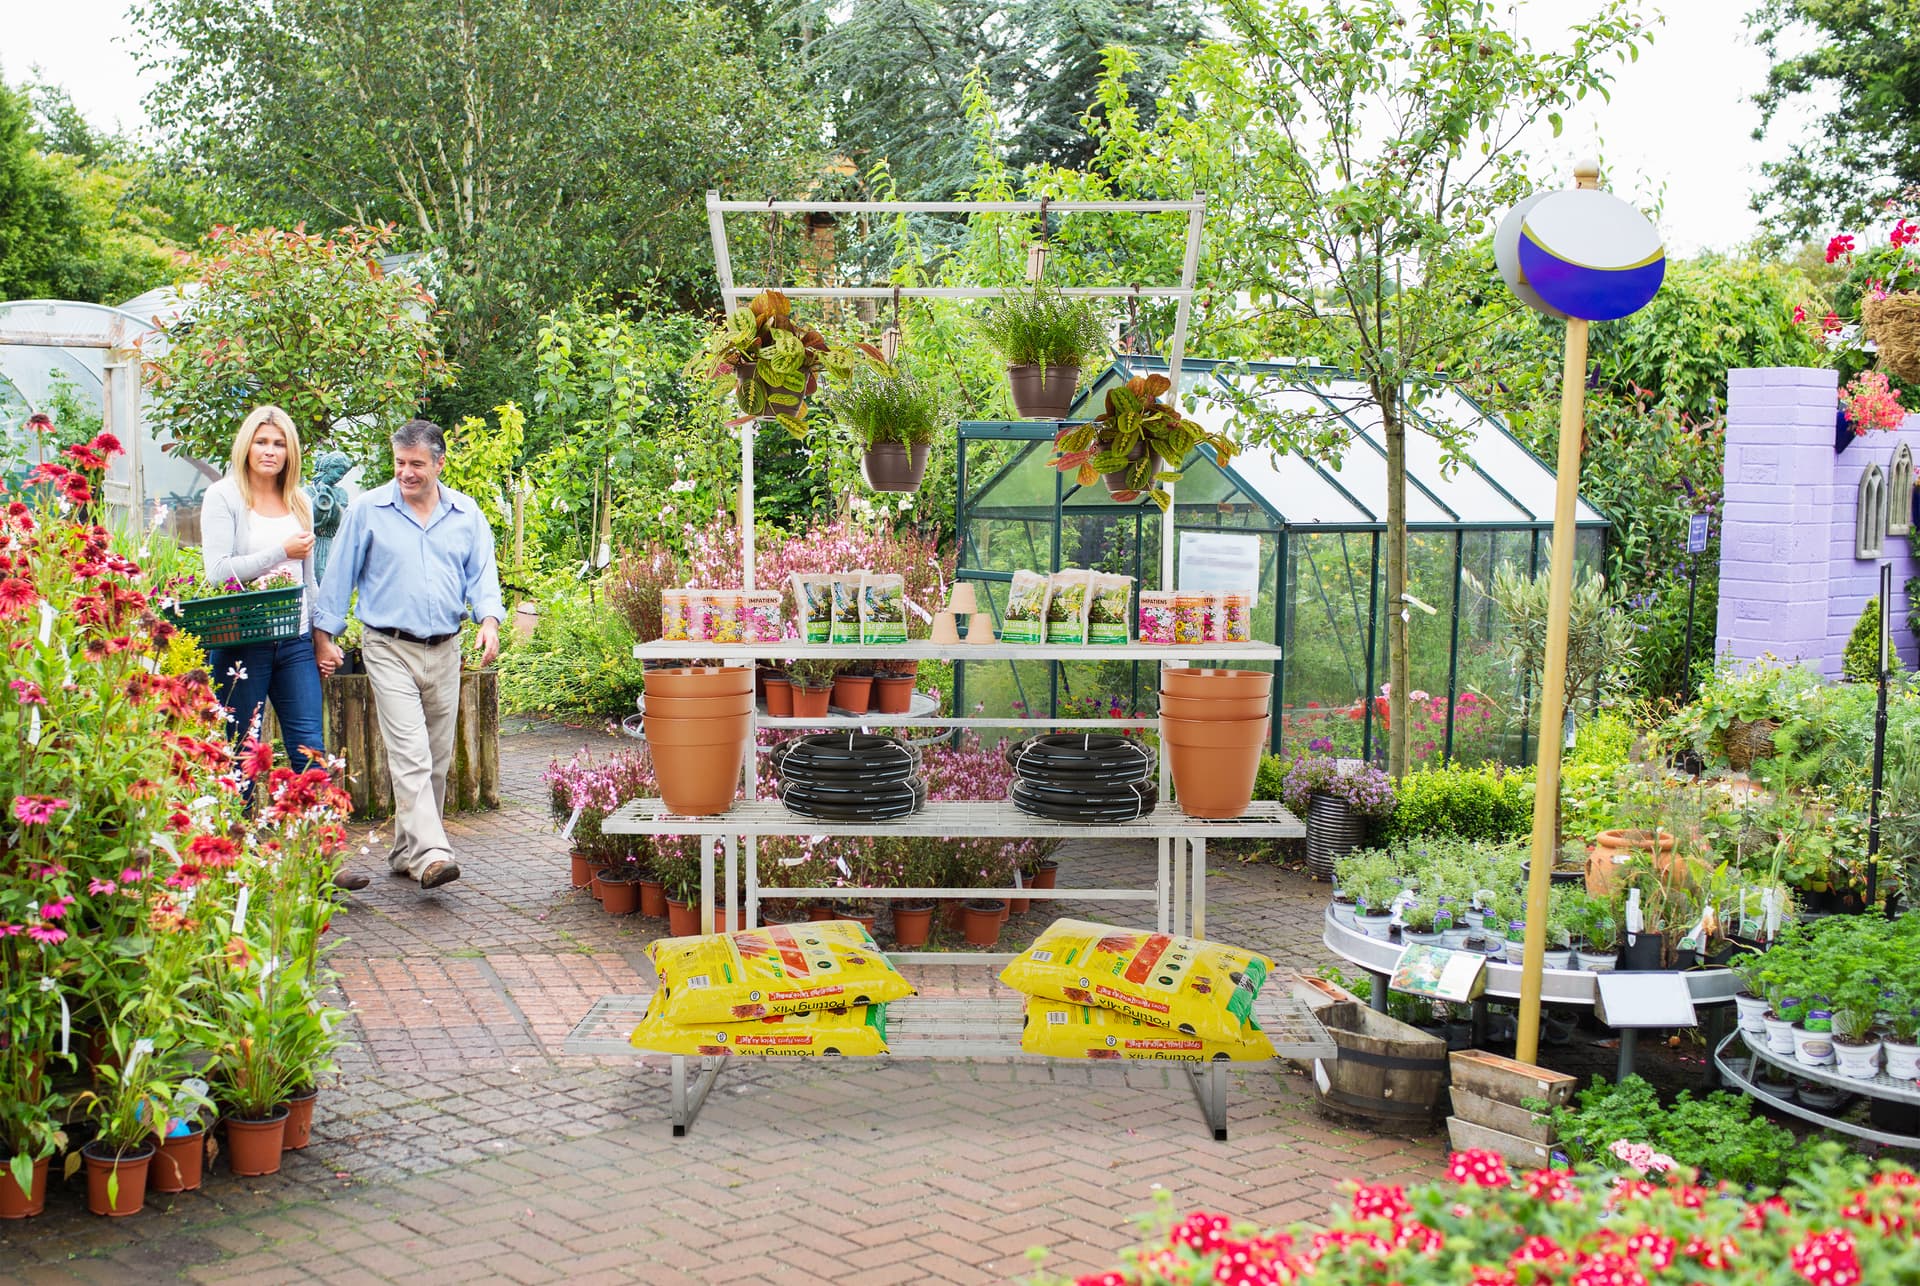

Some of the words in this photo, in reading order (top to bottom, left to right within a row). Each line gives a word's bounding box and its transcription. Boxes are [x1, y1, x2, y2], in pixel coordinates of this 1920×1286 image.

[773, 1004, 796, 1013] Mix
[798, 999, 846, 1011] Potting
[1123, 1005, 1171, 1028] Potting
[765, 1047, 815, 1056] Potting
[1155, 1051, 1204, 1063] Potting
